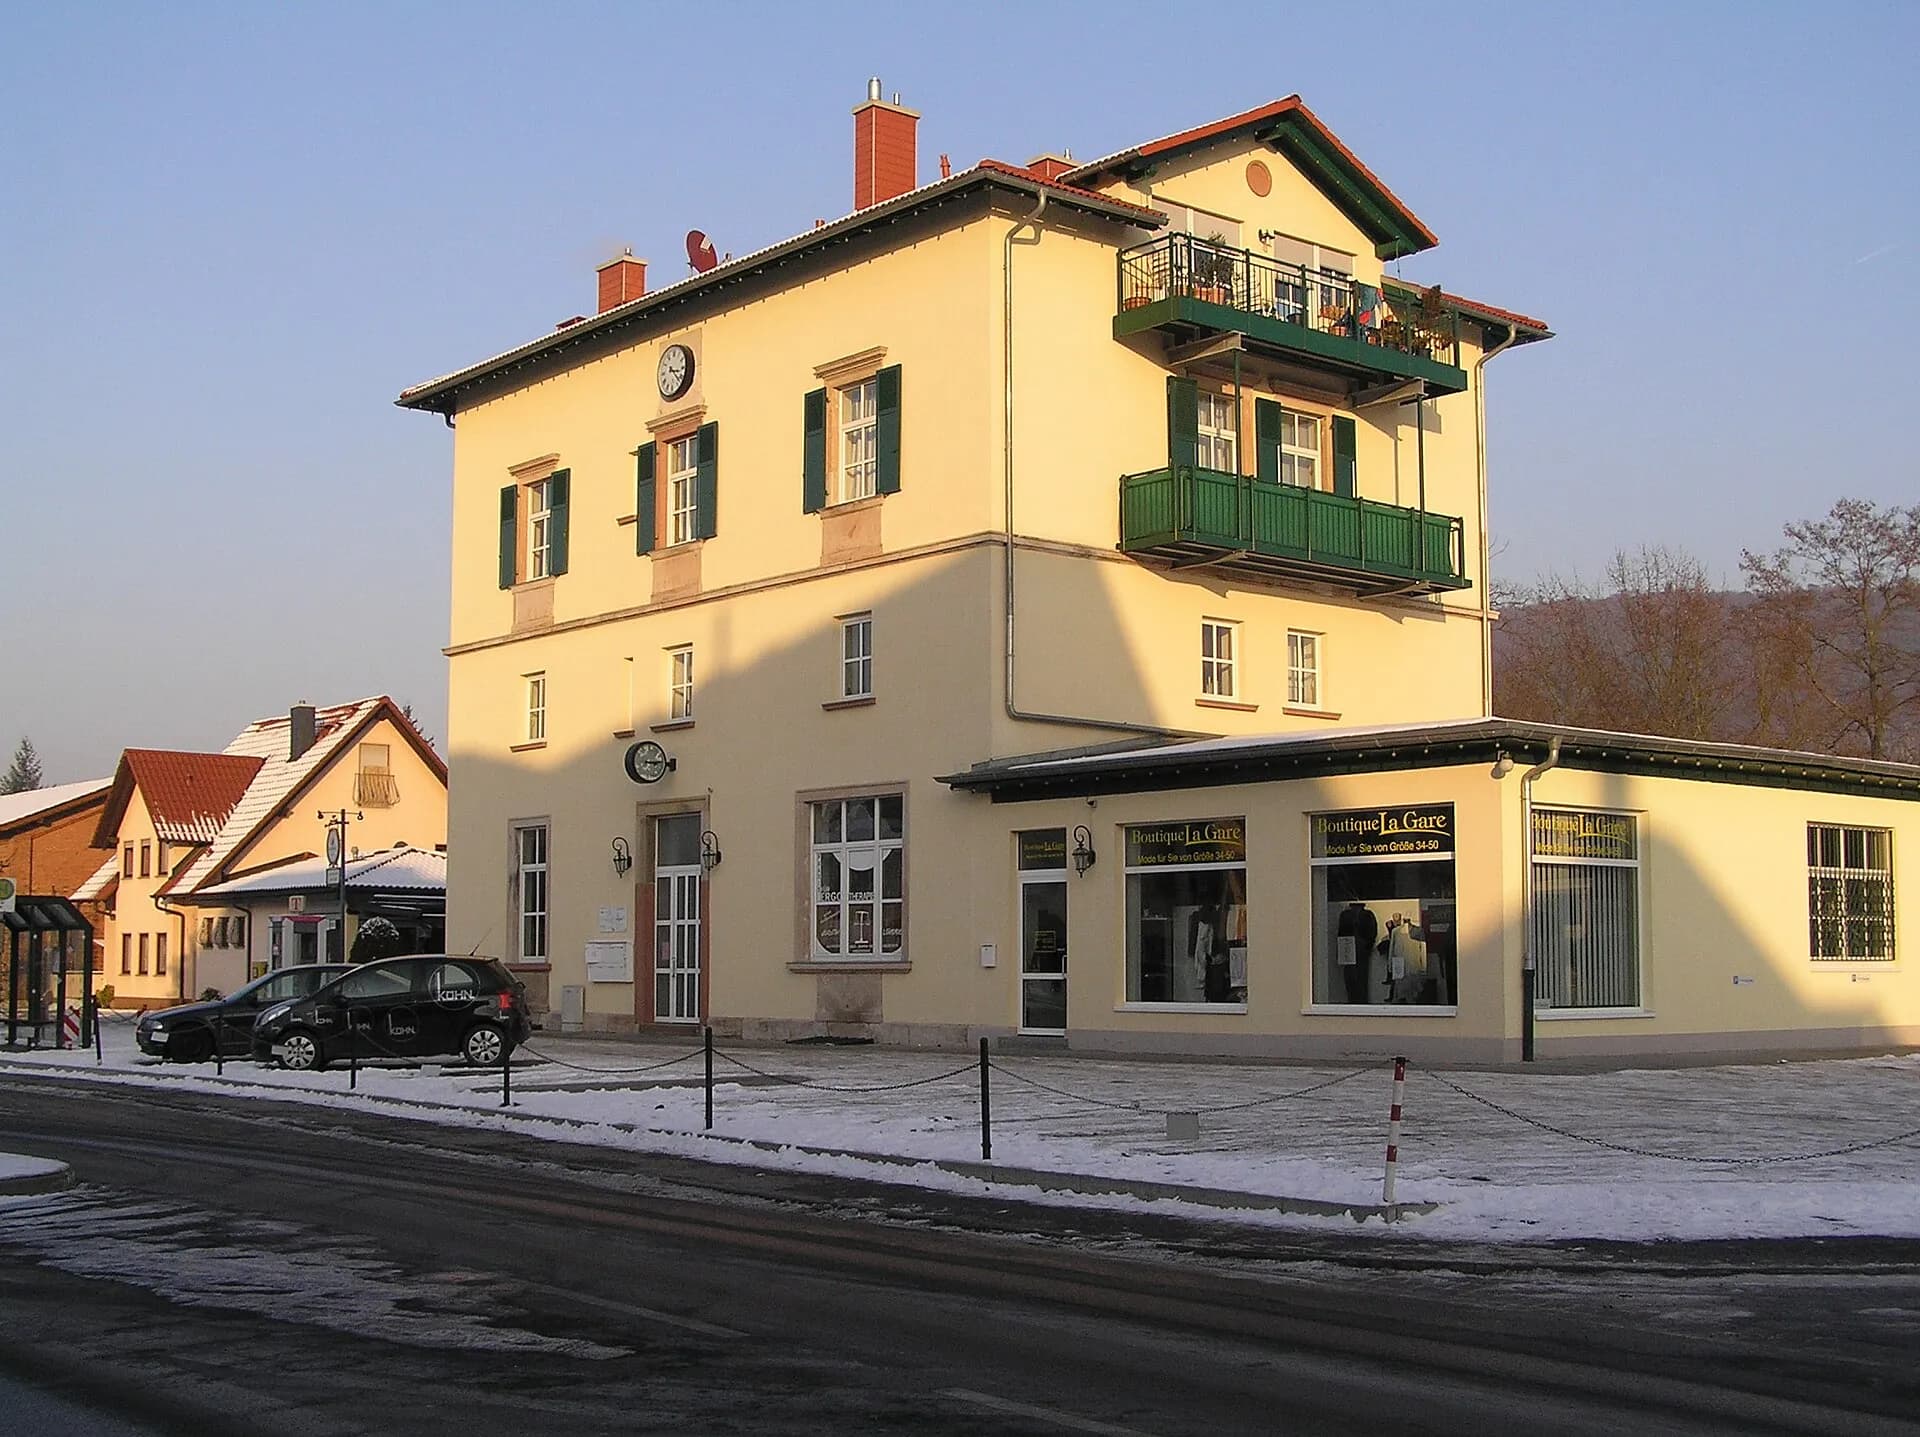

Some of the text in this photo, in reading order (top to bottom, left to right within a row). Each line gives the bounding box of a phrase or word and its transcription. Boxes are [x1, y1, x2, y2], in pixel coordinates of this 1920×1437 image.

[1132, 823, 1241, 846] Boutique La Gare
[1317, 810, 1447, 836] Boutique La Gare
[1359, 843, 1372, 852] Sie
[1372, 844, 1388, 852] von
[1389, 841, 1415, 852] Größe
[1415, 840, 1439, 850] 34-50
